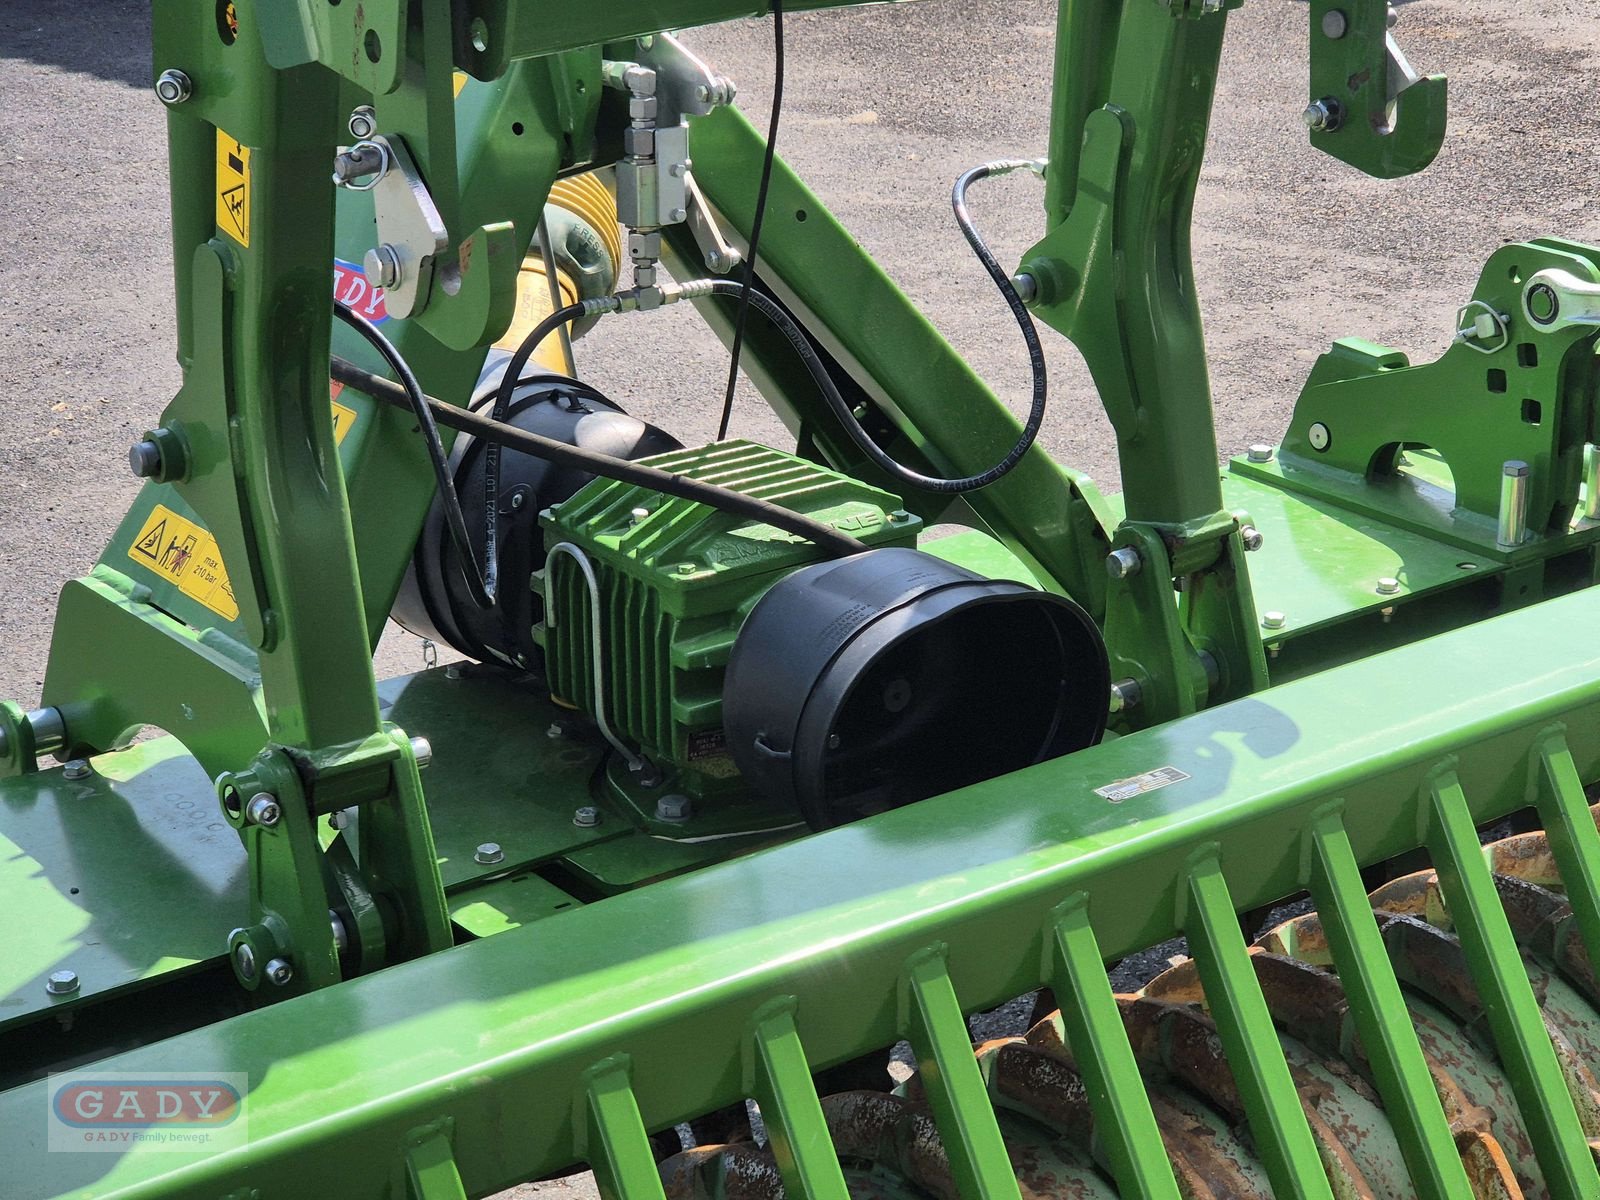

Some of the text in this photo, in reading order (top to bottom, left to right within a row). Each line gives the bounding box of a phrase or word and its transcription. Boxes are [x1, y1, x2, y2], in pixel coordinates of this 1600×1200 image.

[573, 223, 605, 258] PRESS
[1012, 301, 1027, 322] 1200
[1024, 326, 1036, 345] BAR
[1035, 374, 1043, 393] 300
[1032, 399, 1043, 418] BAR
[193, 565, 217, 584] 210 bar
